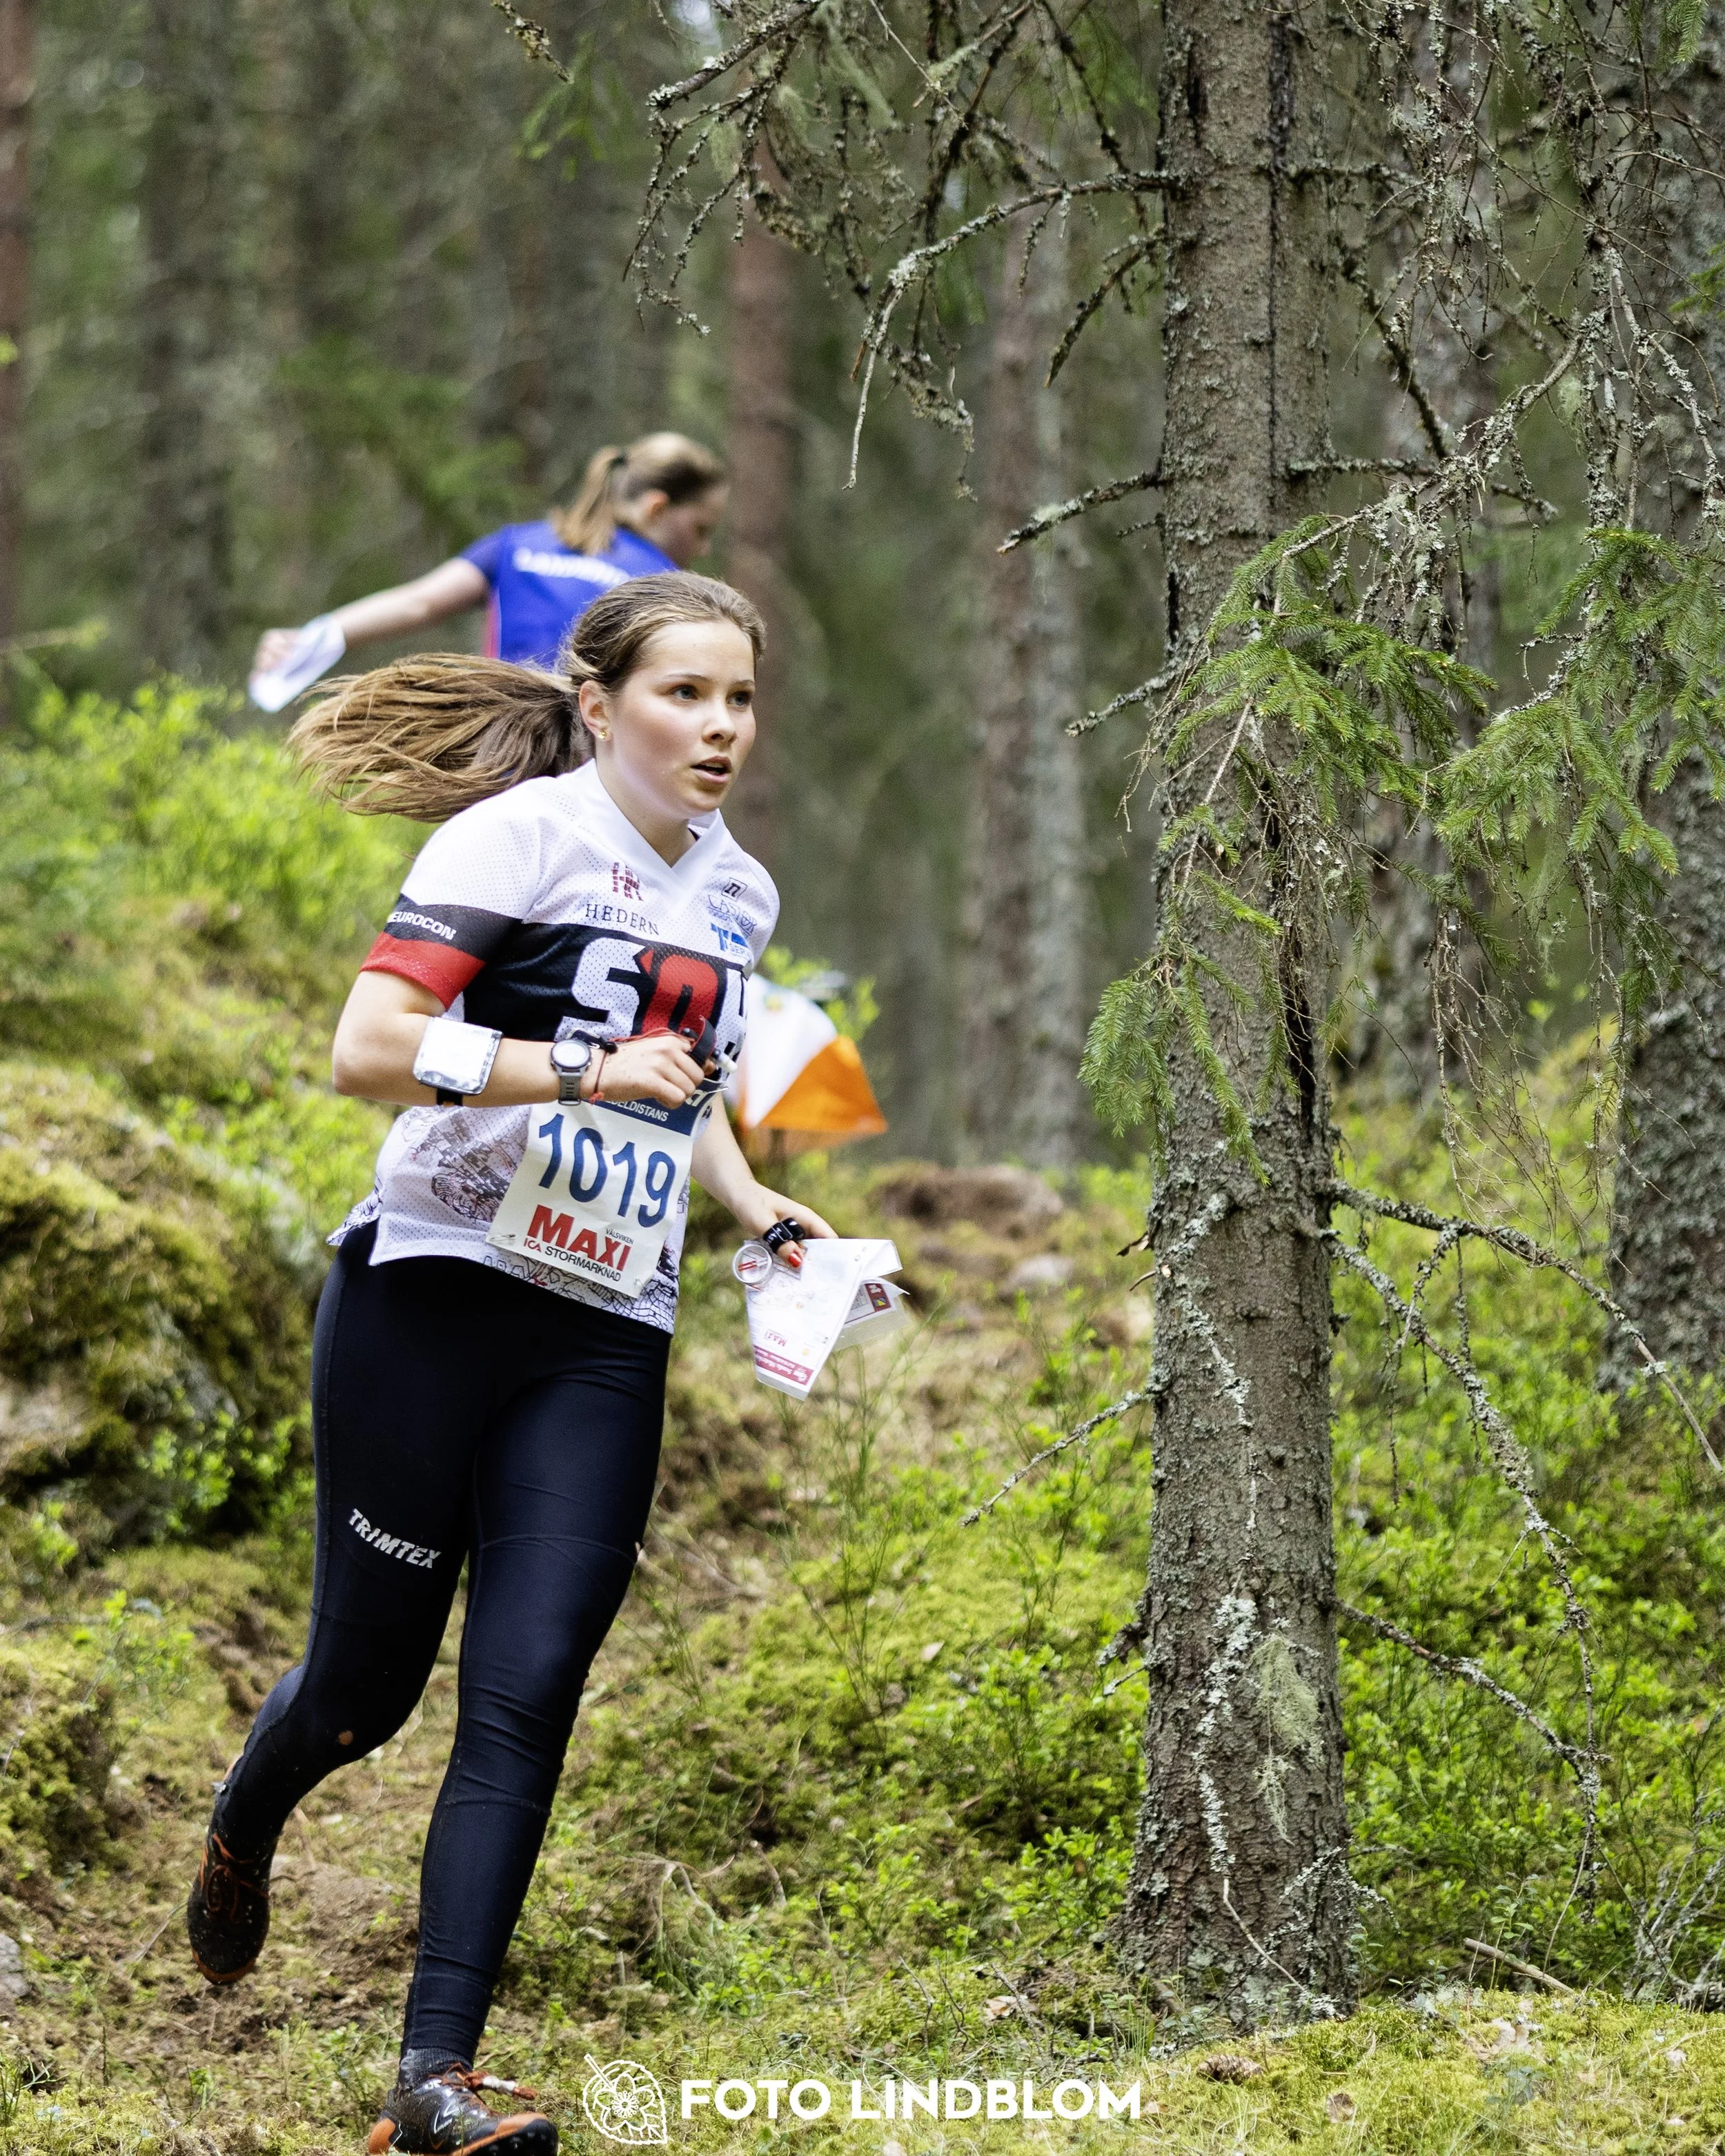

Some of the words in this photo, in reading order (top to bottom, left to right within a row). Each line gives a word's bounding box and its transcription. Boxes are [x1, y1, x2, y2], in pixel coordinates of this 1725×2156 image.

[387, 911, 457, 940] EUROCON
[585, 903, 660, 936] HEDERN
[539, 1113, 677, 1228] 1019
[527, 1204, 631, 1272] MAXI
[605, 1227, 635, 1245] VÄLSVIKEN
[523, 1238, 542, 1253] ICA
[544, 1246, 622, 1283] STORMARKNAD
[348, 1508, 442, 1569] TRIMTEX
